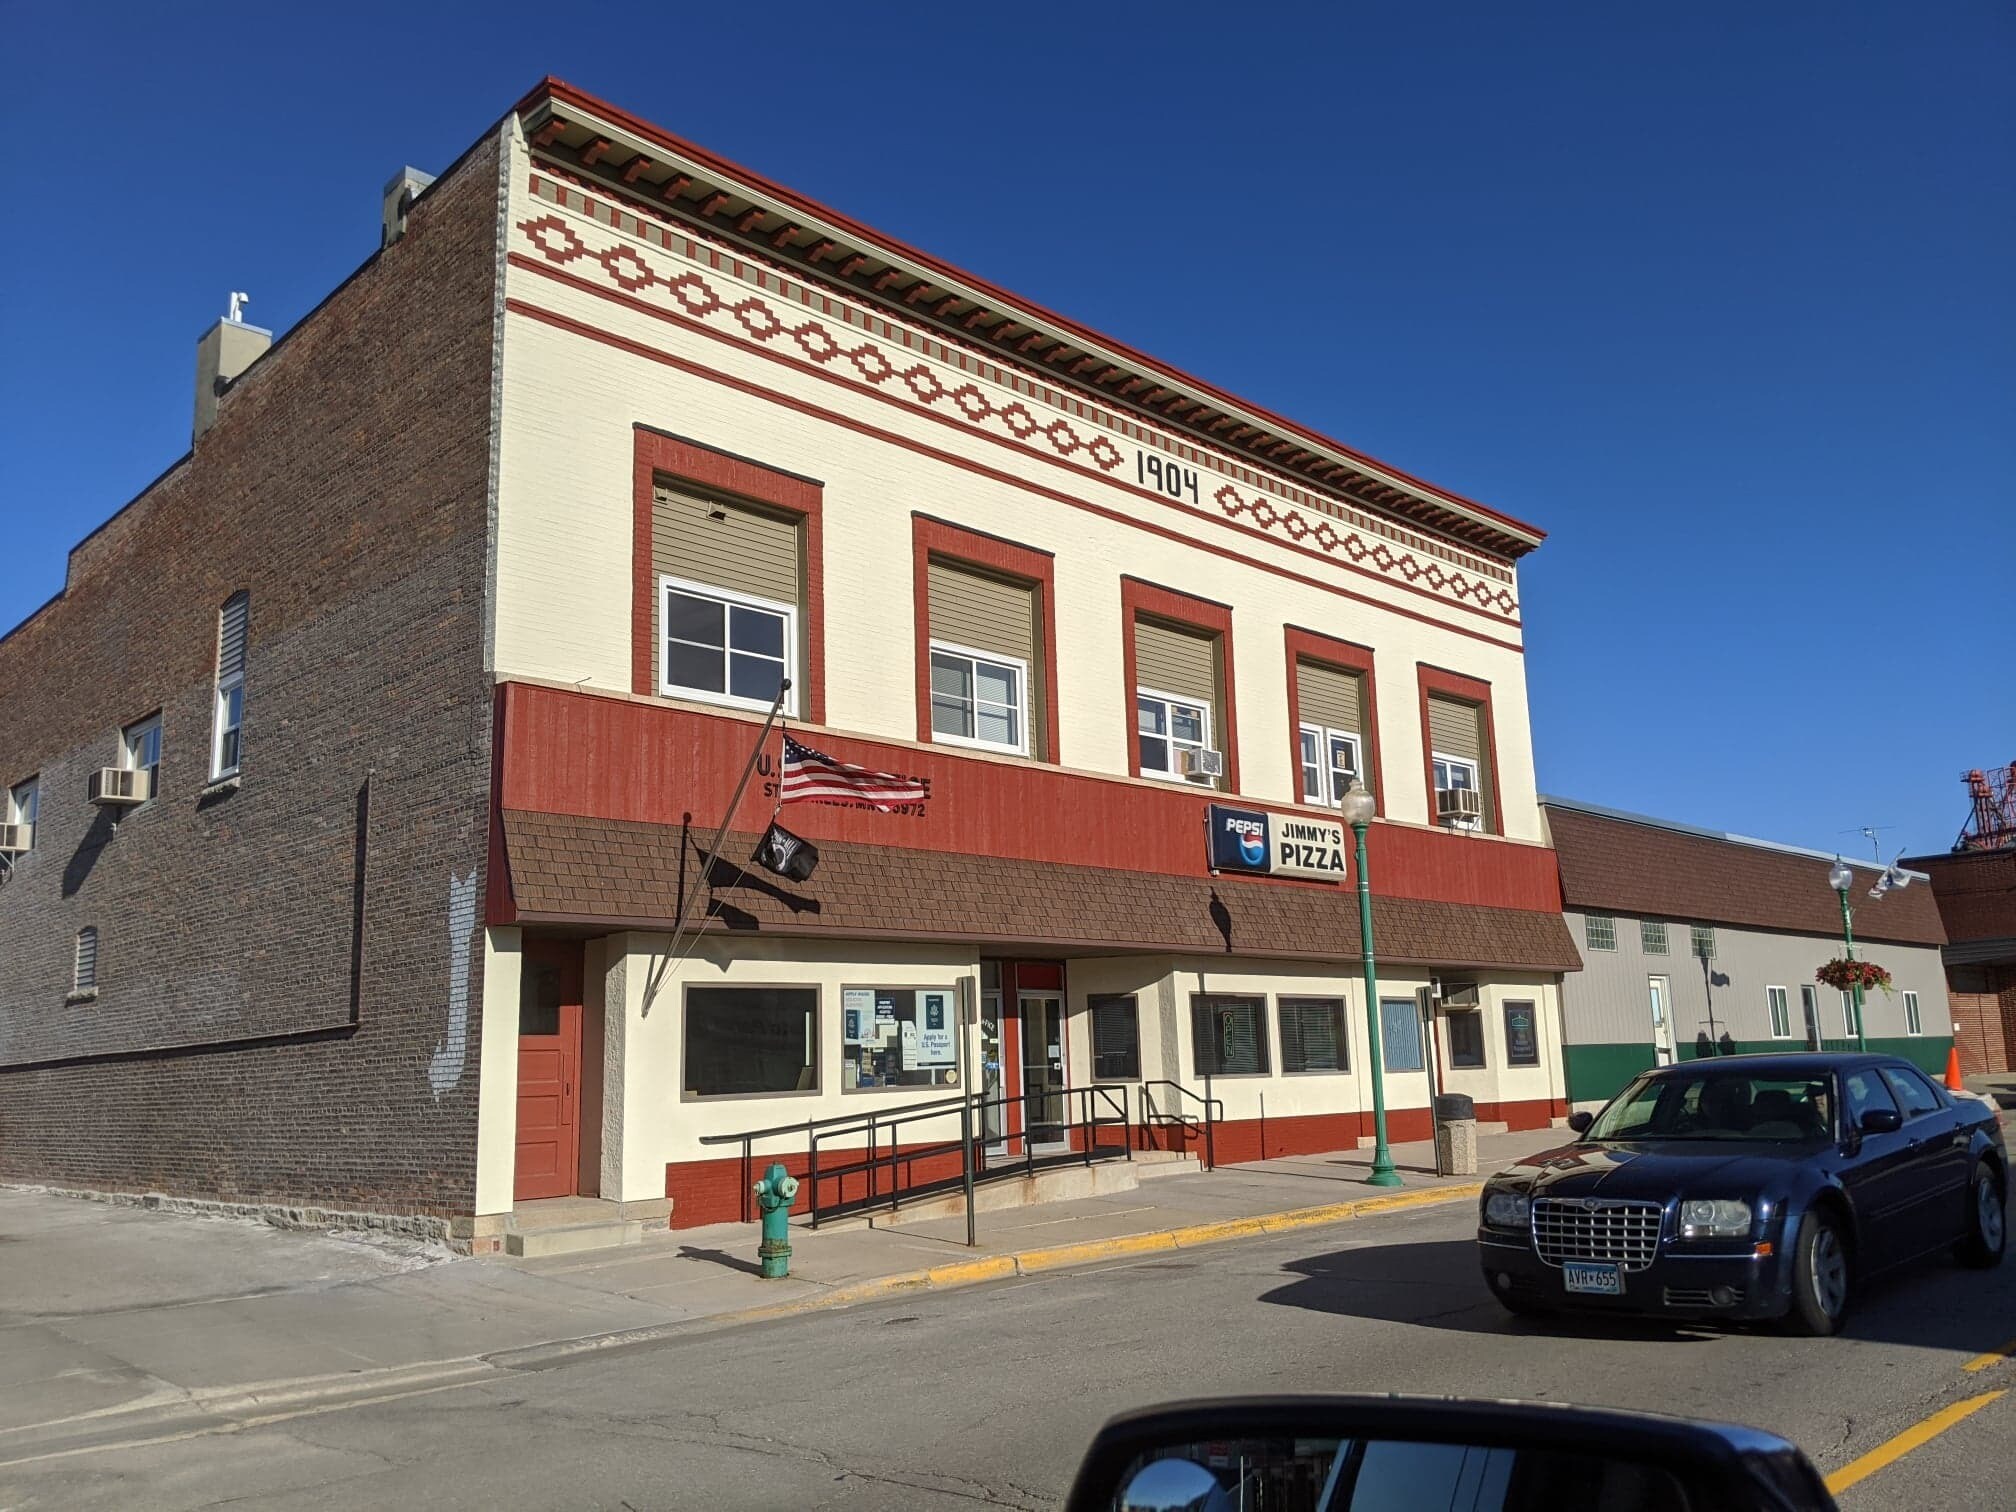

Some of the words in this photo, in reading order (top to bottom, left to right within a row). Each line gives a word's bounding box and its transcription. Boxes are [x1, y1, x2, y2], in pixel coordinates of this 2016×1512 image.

[1137, 449, 1199, 505] 1904
[1225, 818, 1264, 837] PEPSI
[1281, 822, 1341, 845] JIMMY'S
[1280, 842, 1345, 872] PIZZA
